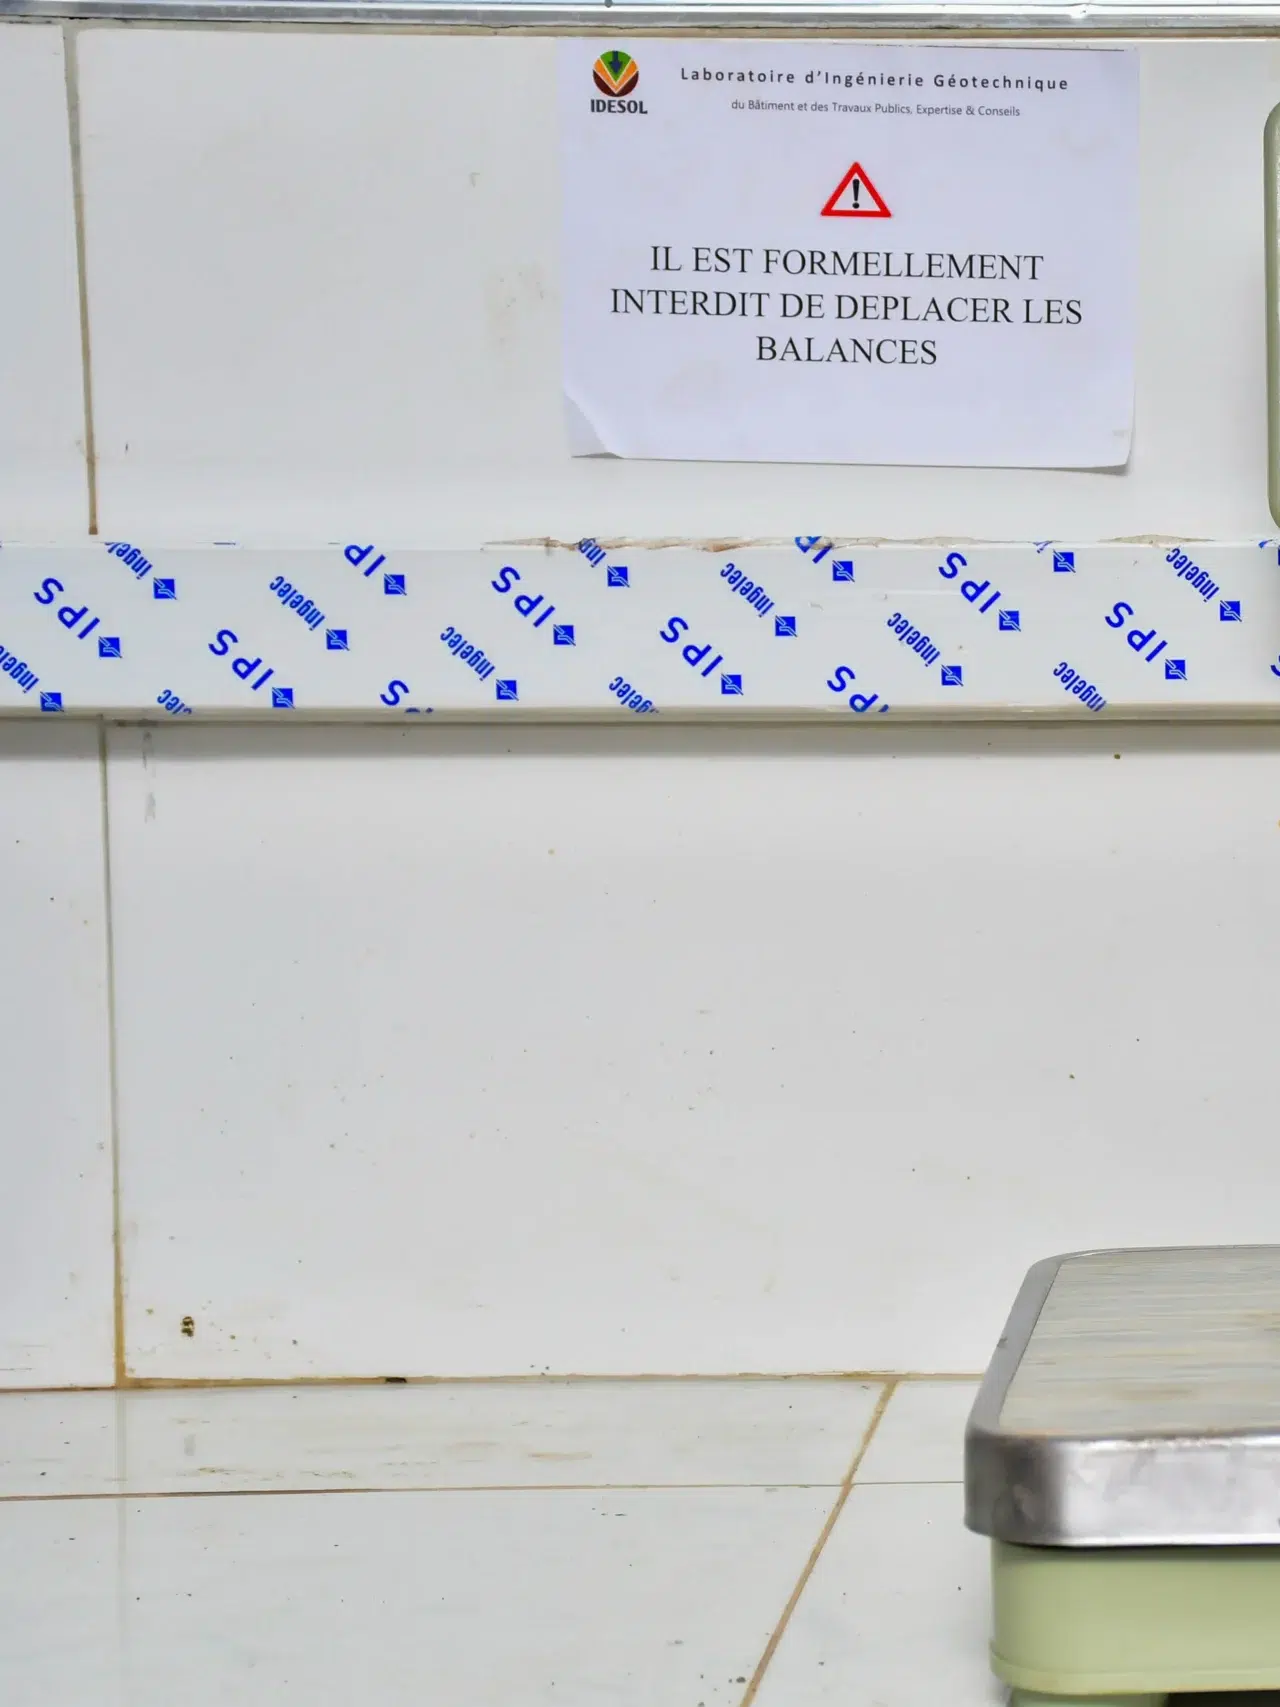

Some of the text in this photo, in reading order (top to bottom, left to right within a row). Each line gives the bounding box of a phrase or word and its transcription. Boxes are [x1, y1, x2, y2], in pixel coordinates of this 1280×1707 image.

[590, 98, 648, 114] IDESOL
[681, 67, 795, 83] Laboratoire
[934, 74, 1068, 93] Géotechnique
[731, 98, 1021, 117] du Bâtiment et des Travaux Publics, Expertise & Conseils
[649, 245, 1045, 281] IL EST FORMELLEMENT
[609, 288, 1083, 326] INTERDIT DE DEPLACER LES
[755, 335, 937, 366] BALANCES
[491, 565, 556, 629] IPS
[720, 562, 776, 617] ingelec
[937, 551, 1002, 614] IPS
[1166, 547, 1220, 602] ingelec
[33, 576, 101, 640] IPS
[268, 575, 327, 631] ingelec
[207, 627, 274, 691] IPS
[440, 626, 496, 680] ingelec
[659, 615, 725, 678] IPS
[887, 612, 941, 666] ingelec
[1104, 600, 1168, 664] IPS
